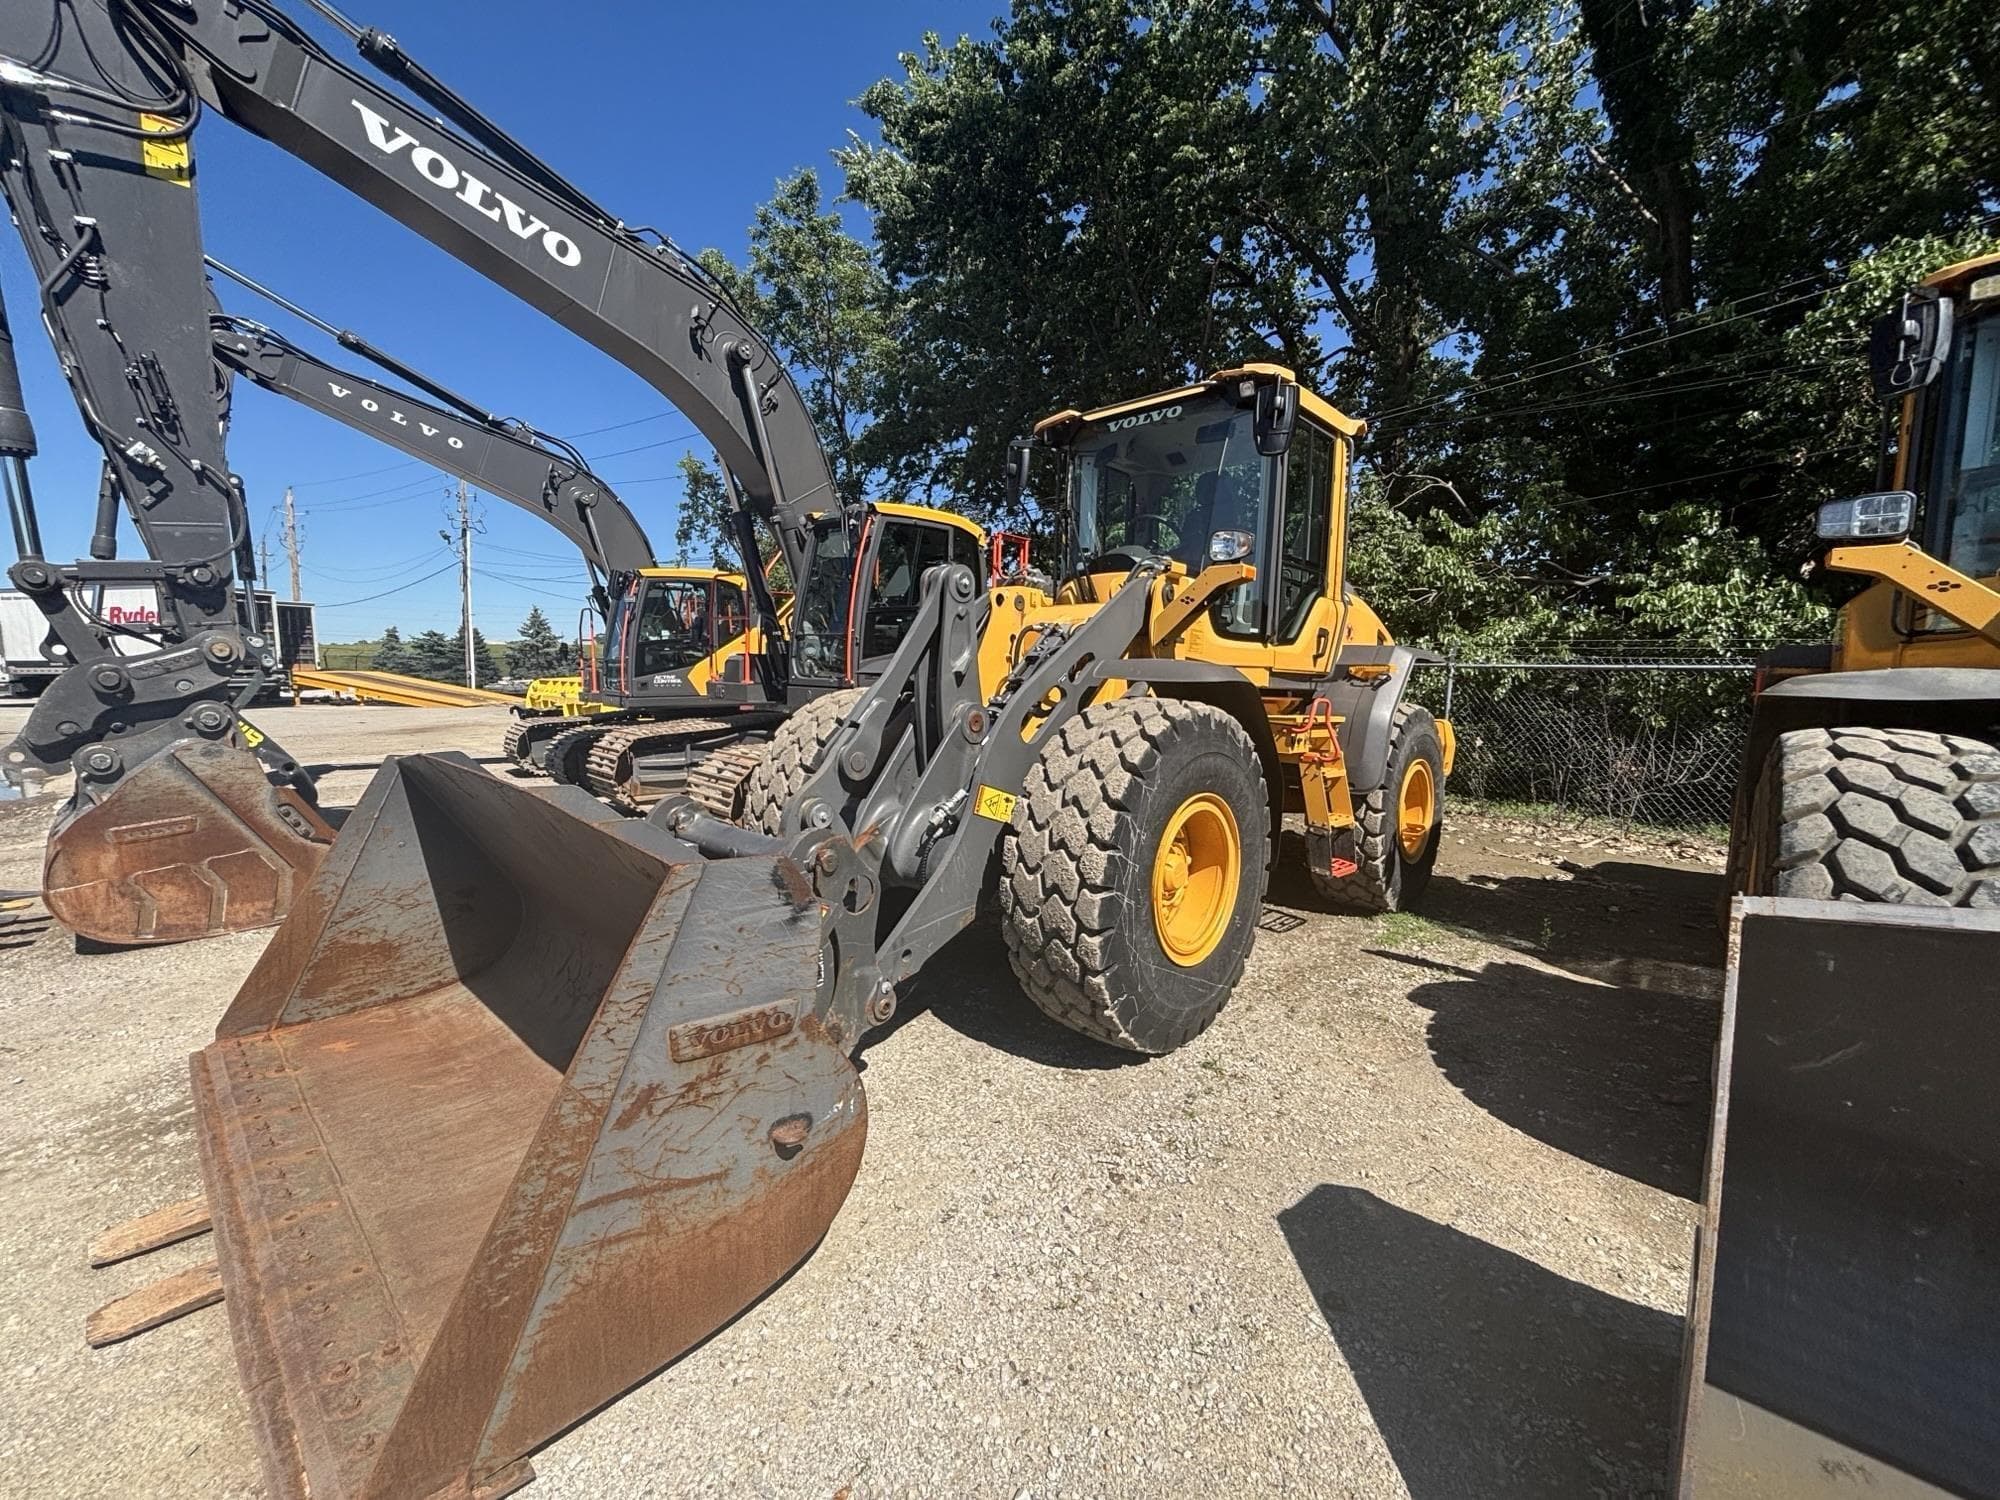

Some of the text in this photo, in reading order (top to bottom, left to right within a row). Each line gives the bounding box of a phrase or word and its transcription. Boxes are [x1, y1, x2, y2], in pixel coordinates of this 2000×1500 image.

[352, 99, 582, 267] VOLVO
[328, 382, 463, 449] VOLVO
[1107, 405, 1183, 433] VOLVO
